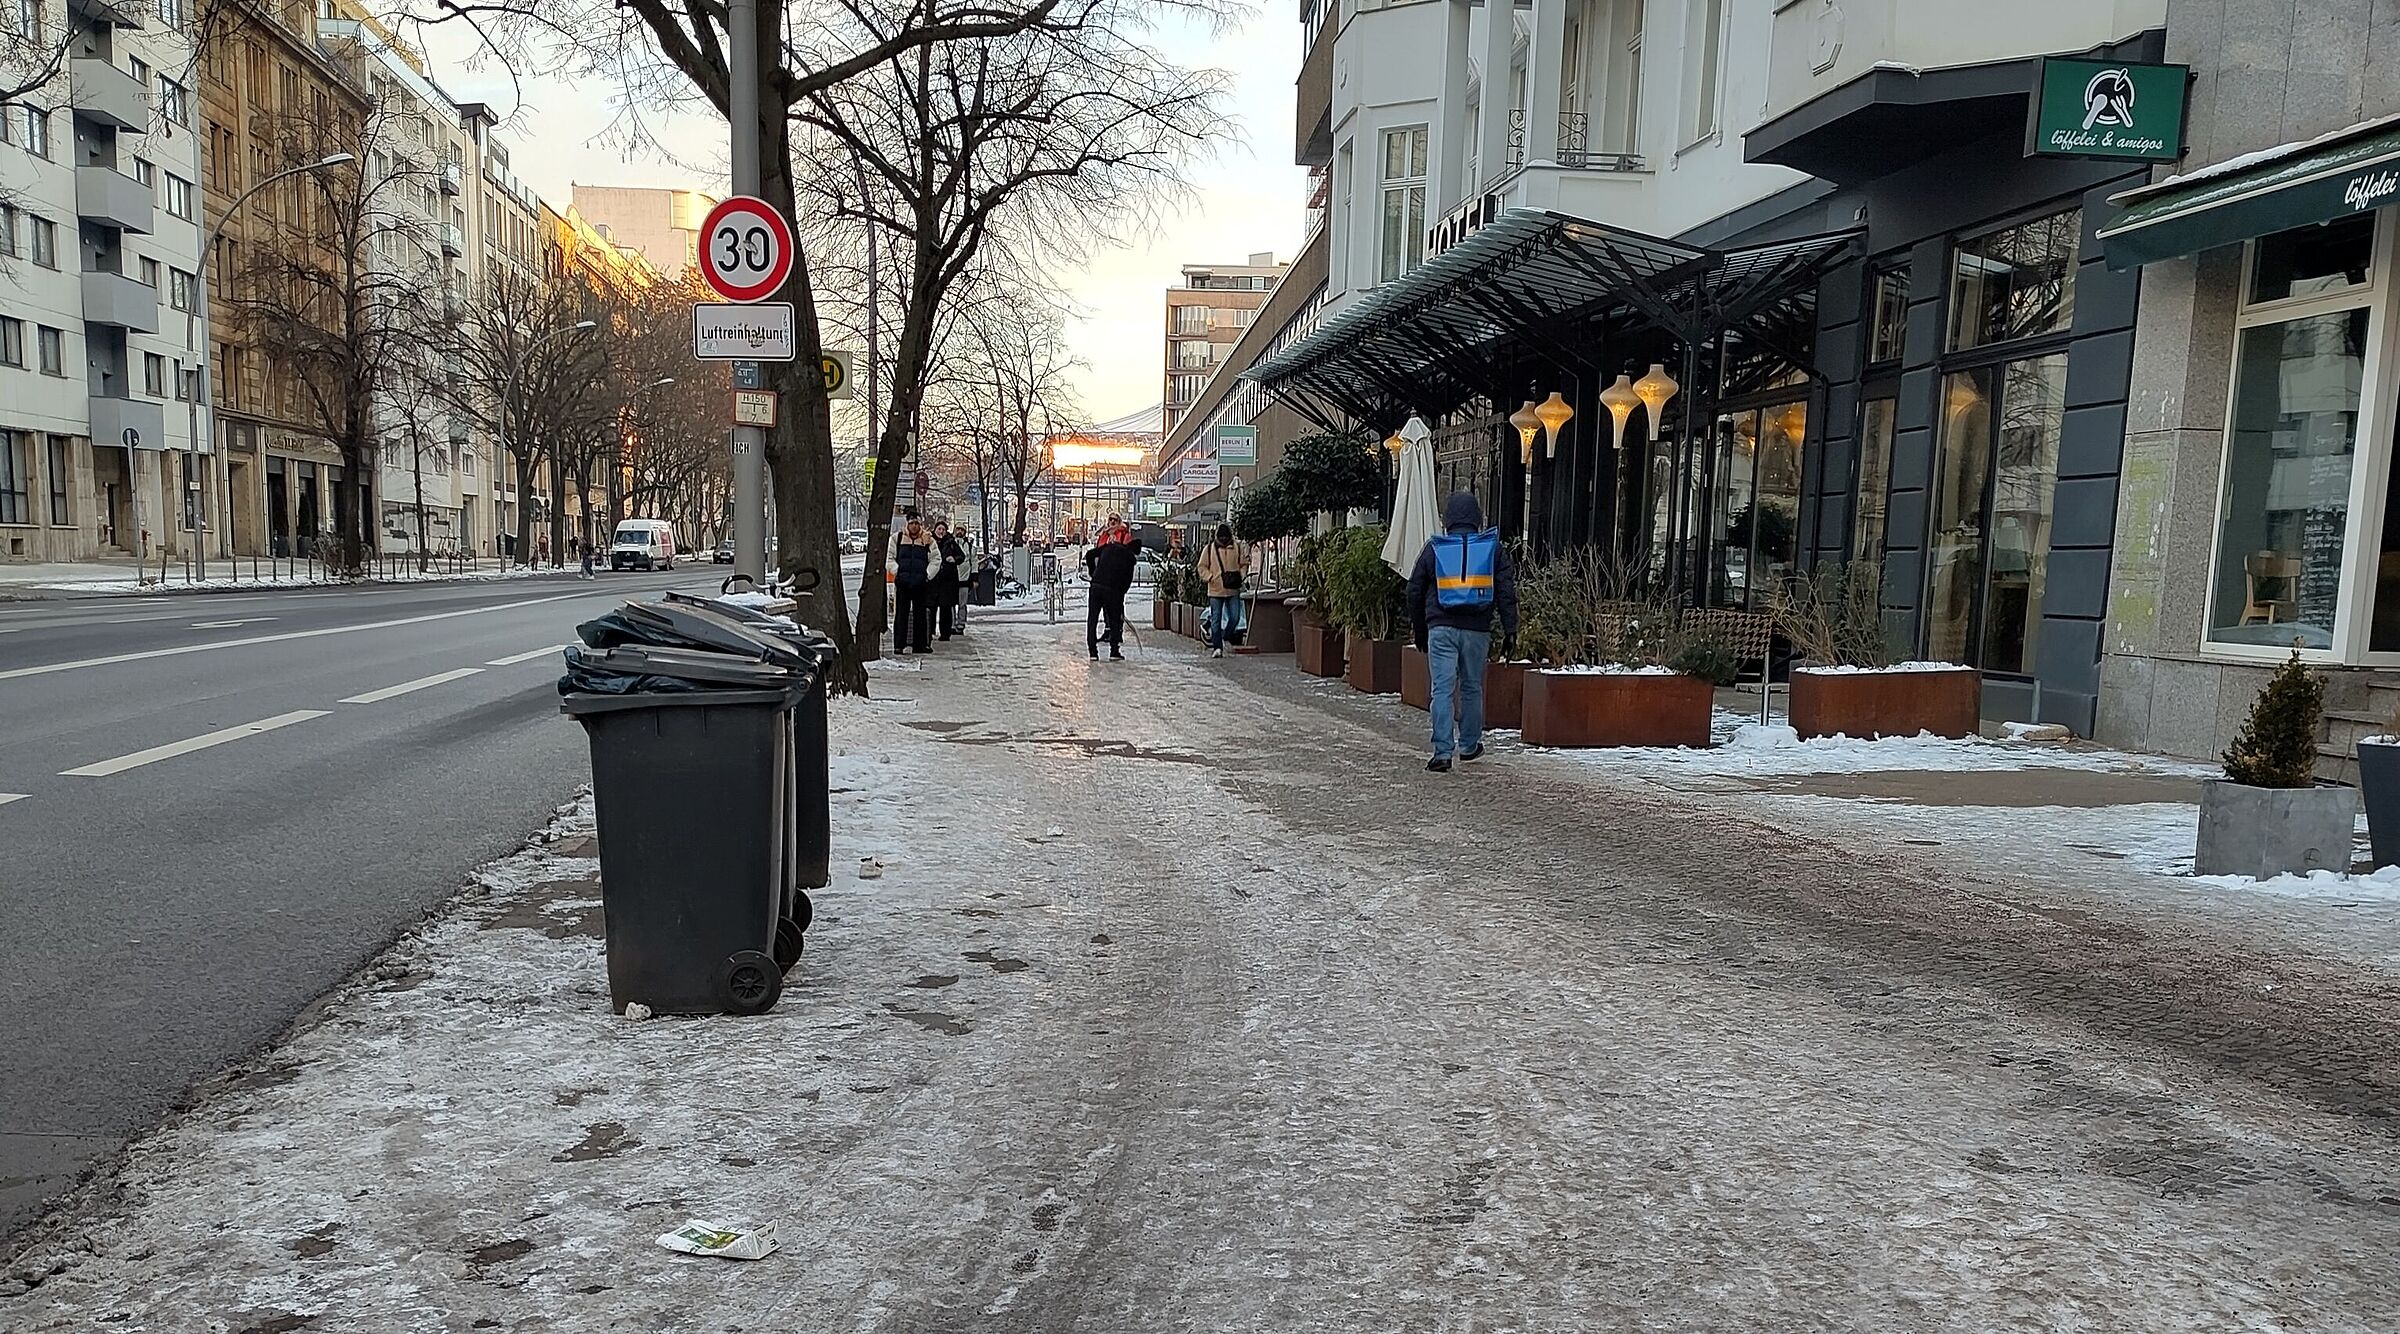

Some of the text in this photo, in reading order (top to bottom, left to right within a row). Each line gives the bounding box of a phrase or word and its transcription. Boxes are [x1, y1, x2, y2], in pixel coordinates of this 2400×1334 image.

[2051, 129, 2164, 155] löffelei & amigos
[2344, 170, 2400, 211] löffelei
[717, 226, 770, 272] 30
